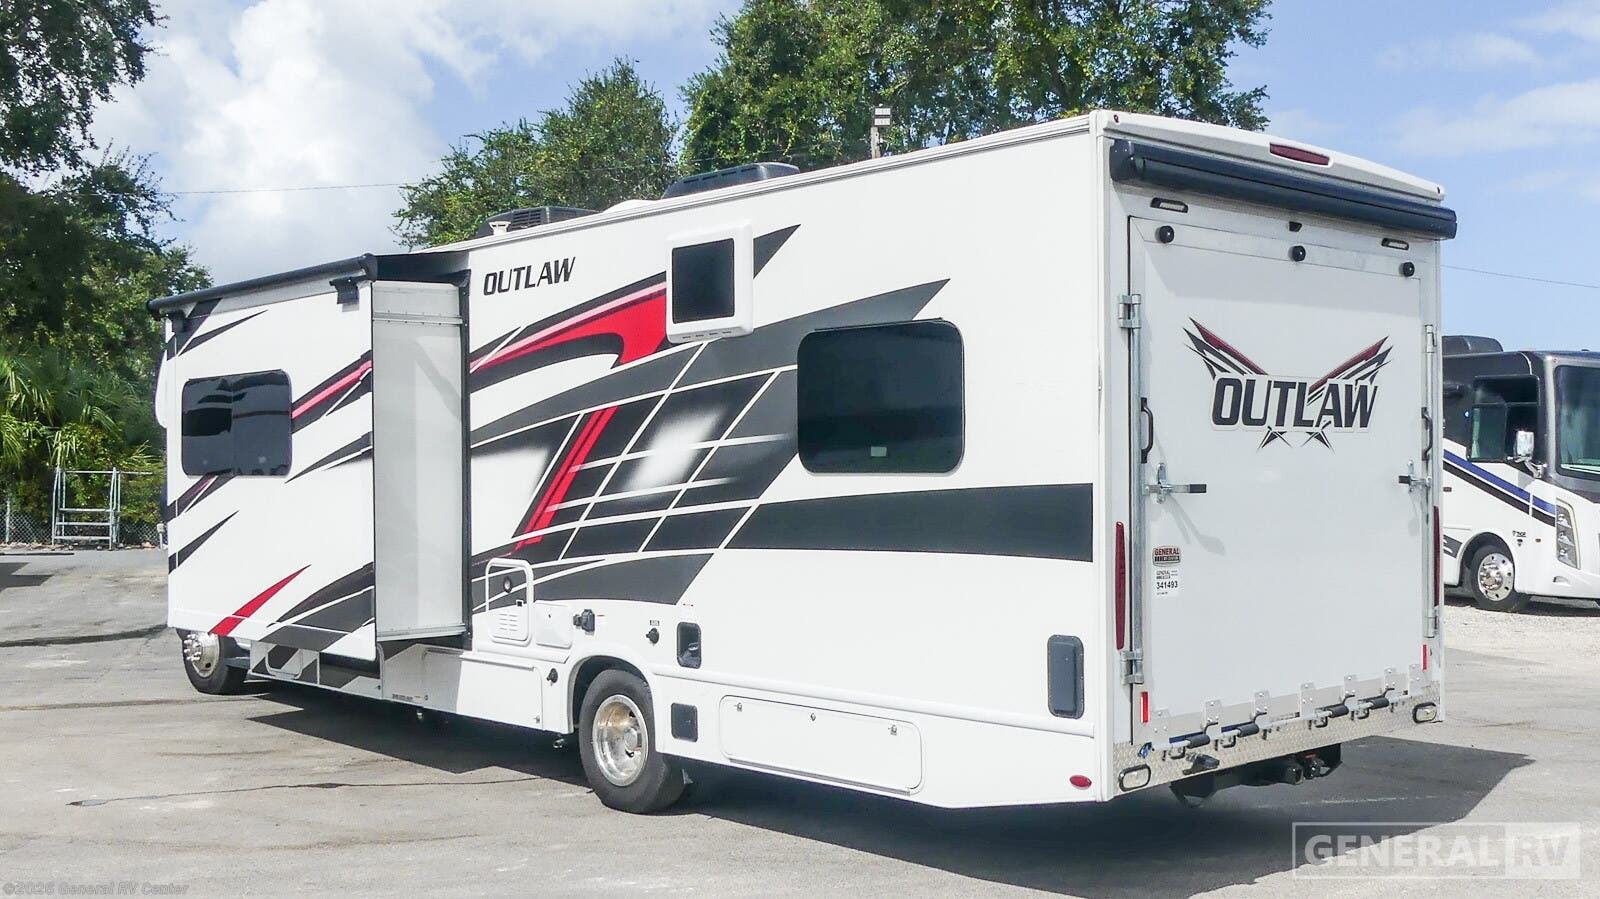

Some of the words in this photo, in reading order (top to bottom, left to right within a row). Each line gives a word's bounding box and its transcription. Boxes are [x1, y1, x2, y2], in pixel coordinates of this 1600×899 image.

[483, 257, 576, 296] OUTLAW
[1212, 377, 1378, 428] OUTLAW
[1156, 581, 1178, 589] 341493
